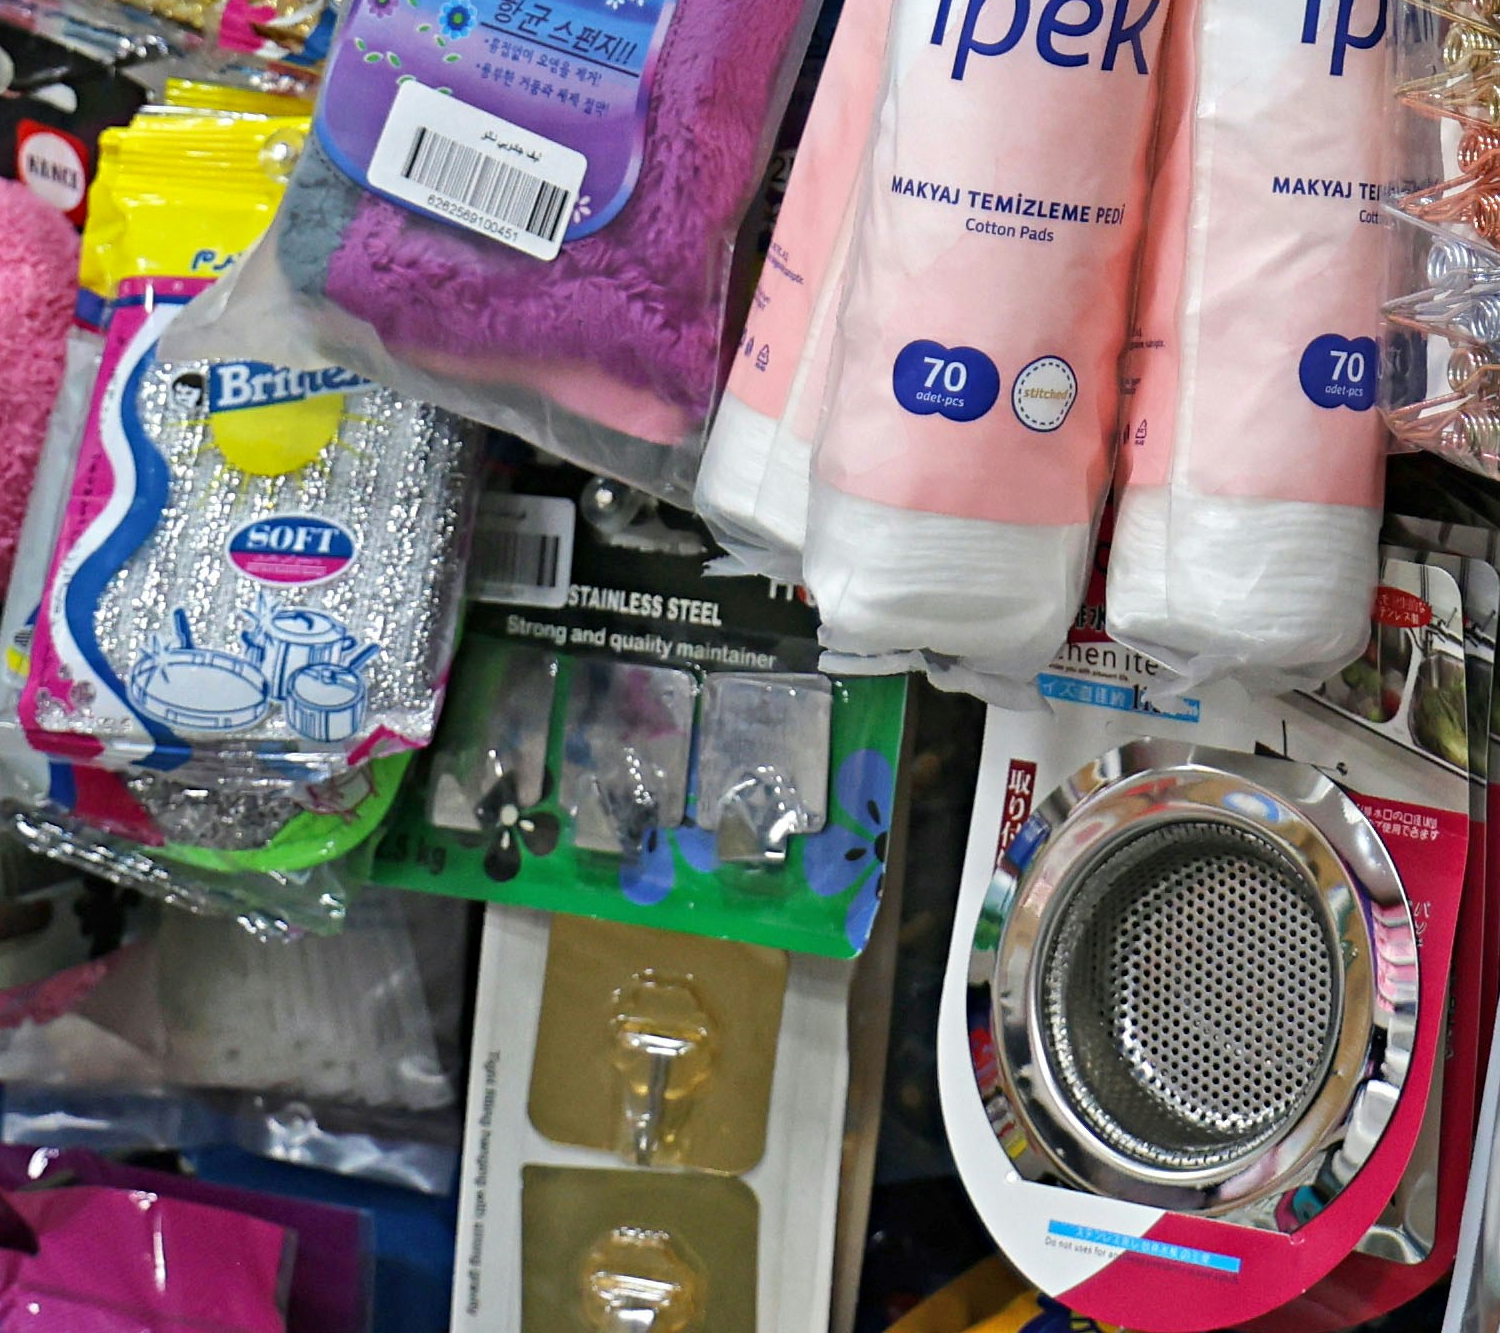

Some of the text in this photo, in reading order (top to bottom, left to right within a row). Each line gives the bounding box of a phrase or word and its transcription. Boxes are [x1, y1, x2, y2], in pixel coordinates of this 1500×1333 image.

[891, 175, 1127, 226] MAKYAJ TEMİZLEME PEDİ
[1271, 176, 1352, 200] MAKYAJ
[965, 217, 1055, 243] Cotton Pads
[923, 356, 968, 393] 70
[1330, 350, 1365, 383] 70
[245, 524, 340, 553] SOFT
[567, 582, 722, 627] STAINLESS STEEL
[506, 614, 778, 669] Strong and quality maintainer
